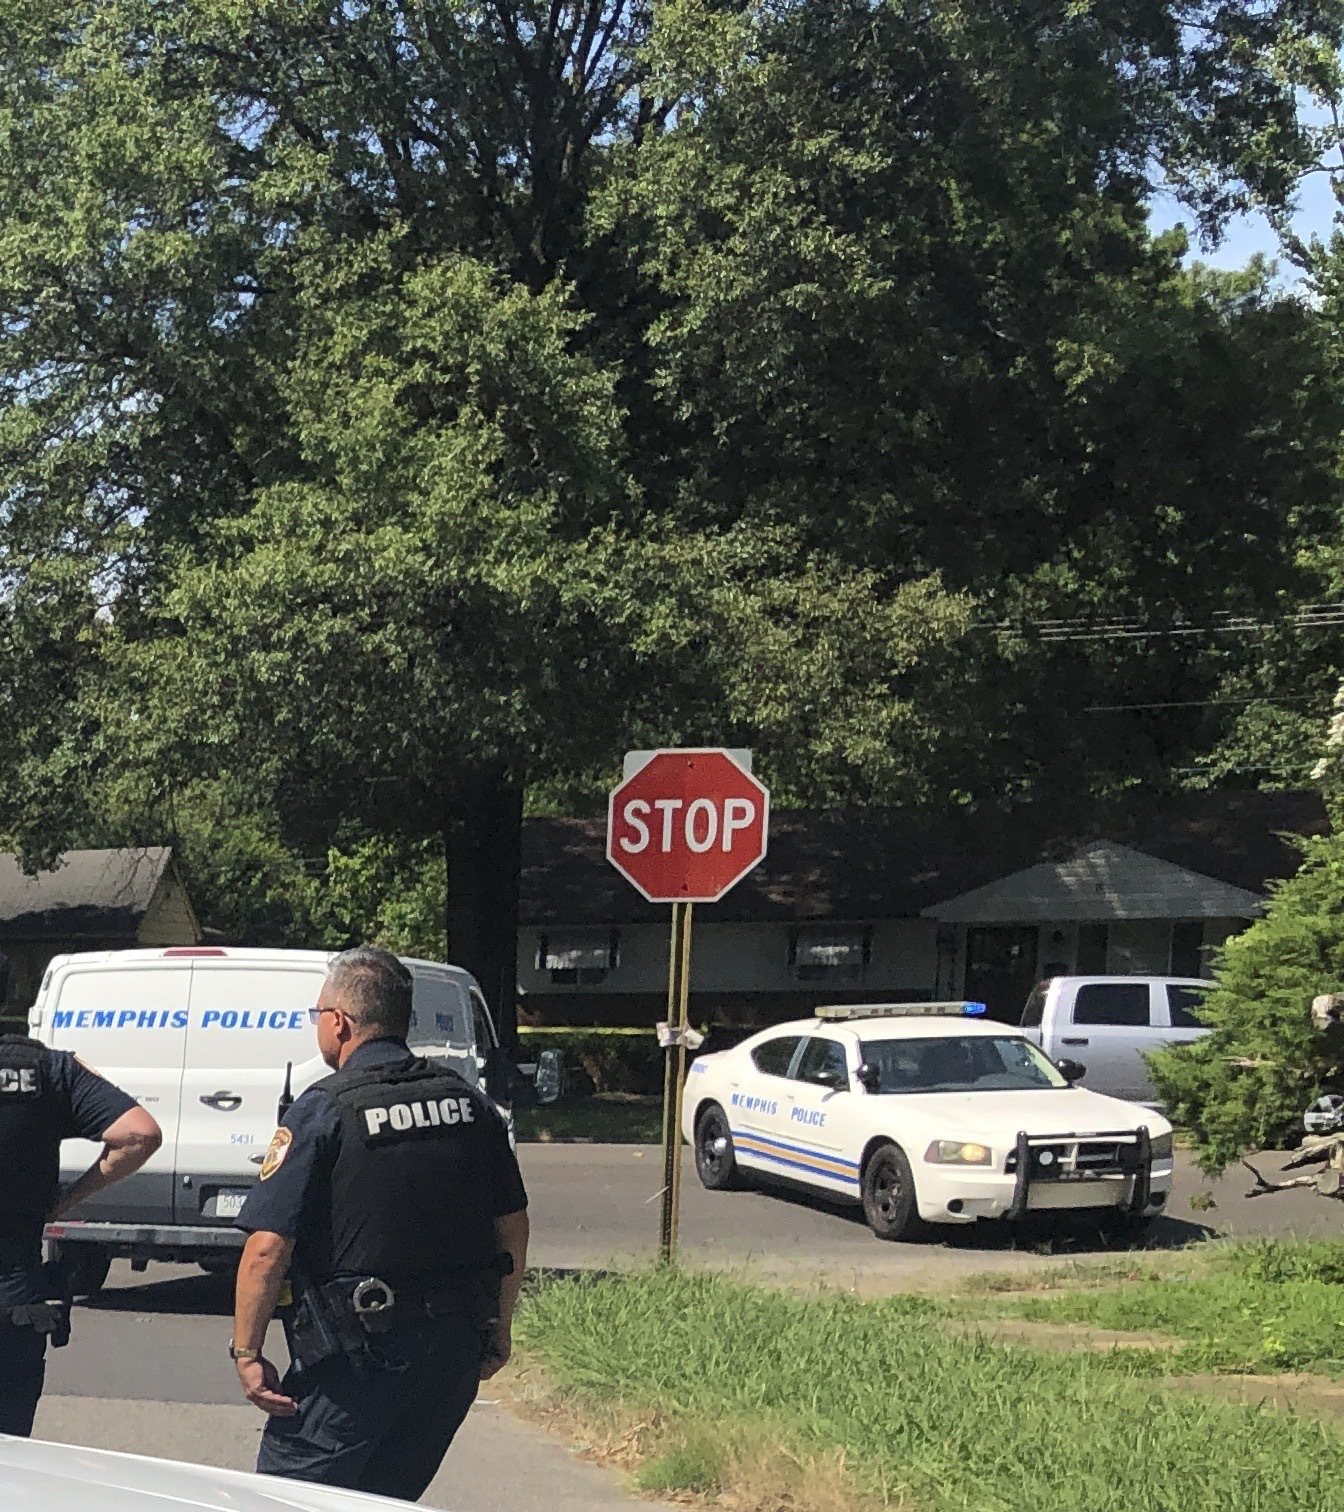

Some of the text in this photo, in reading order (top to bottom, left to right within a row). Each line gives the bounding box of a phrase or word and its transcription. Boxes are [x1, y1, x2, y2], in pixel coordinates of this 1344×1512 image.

[619, 798, 756, 854] STOP
[54, 1010, 307, 1029] MEMPHIS POLICE
[364, 1098, 475, 1136] POLICE
[731, 1093, 827, 1127] MEMPHIS POLICE
[230, 1133, 254, 1145] 5431
